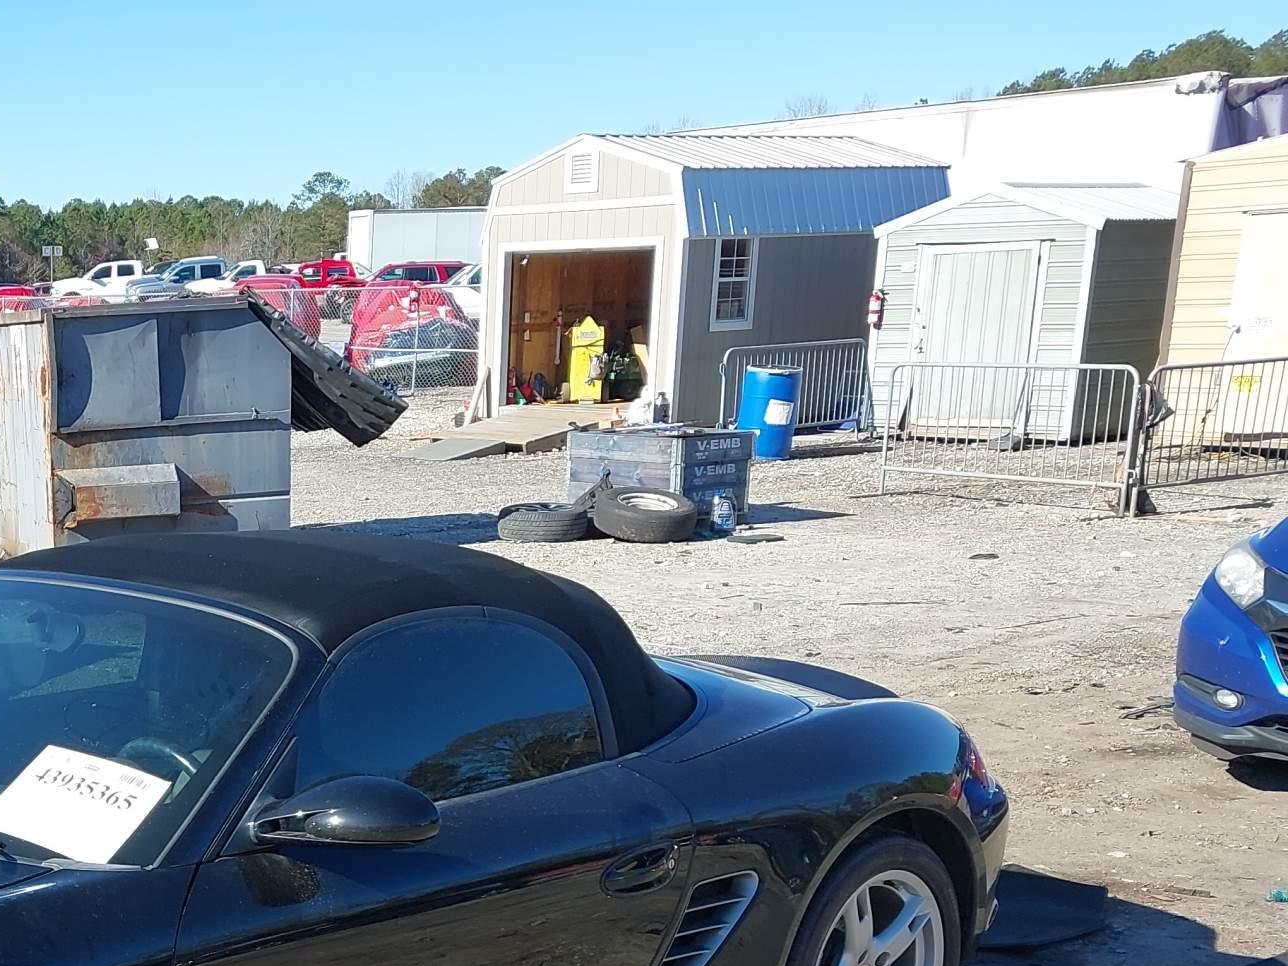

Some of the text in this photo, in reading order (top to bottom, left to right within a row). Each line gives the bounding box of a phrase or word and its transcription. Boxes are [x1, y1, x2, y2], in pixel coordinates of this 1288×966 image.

[696, 437, 741, 451] V-EMB
[694, 463, 736, 477] V-EMB
[35, 768, 138, 810] 43935365
